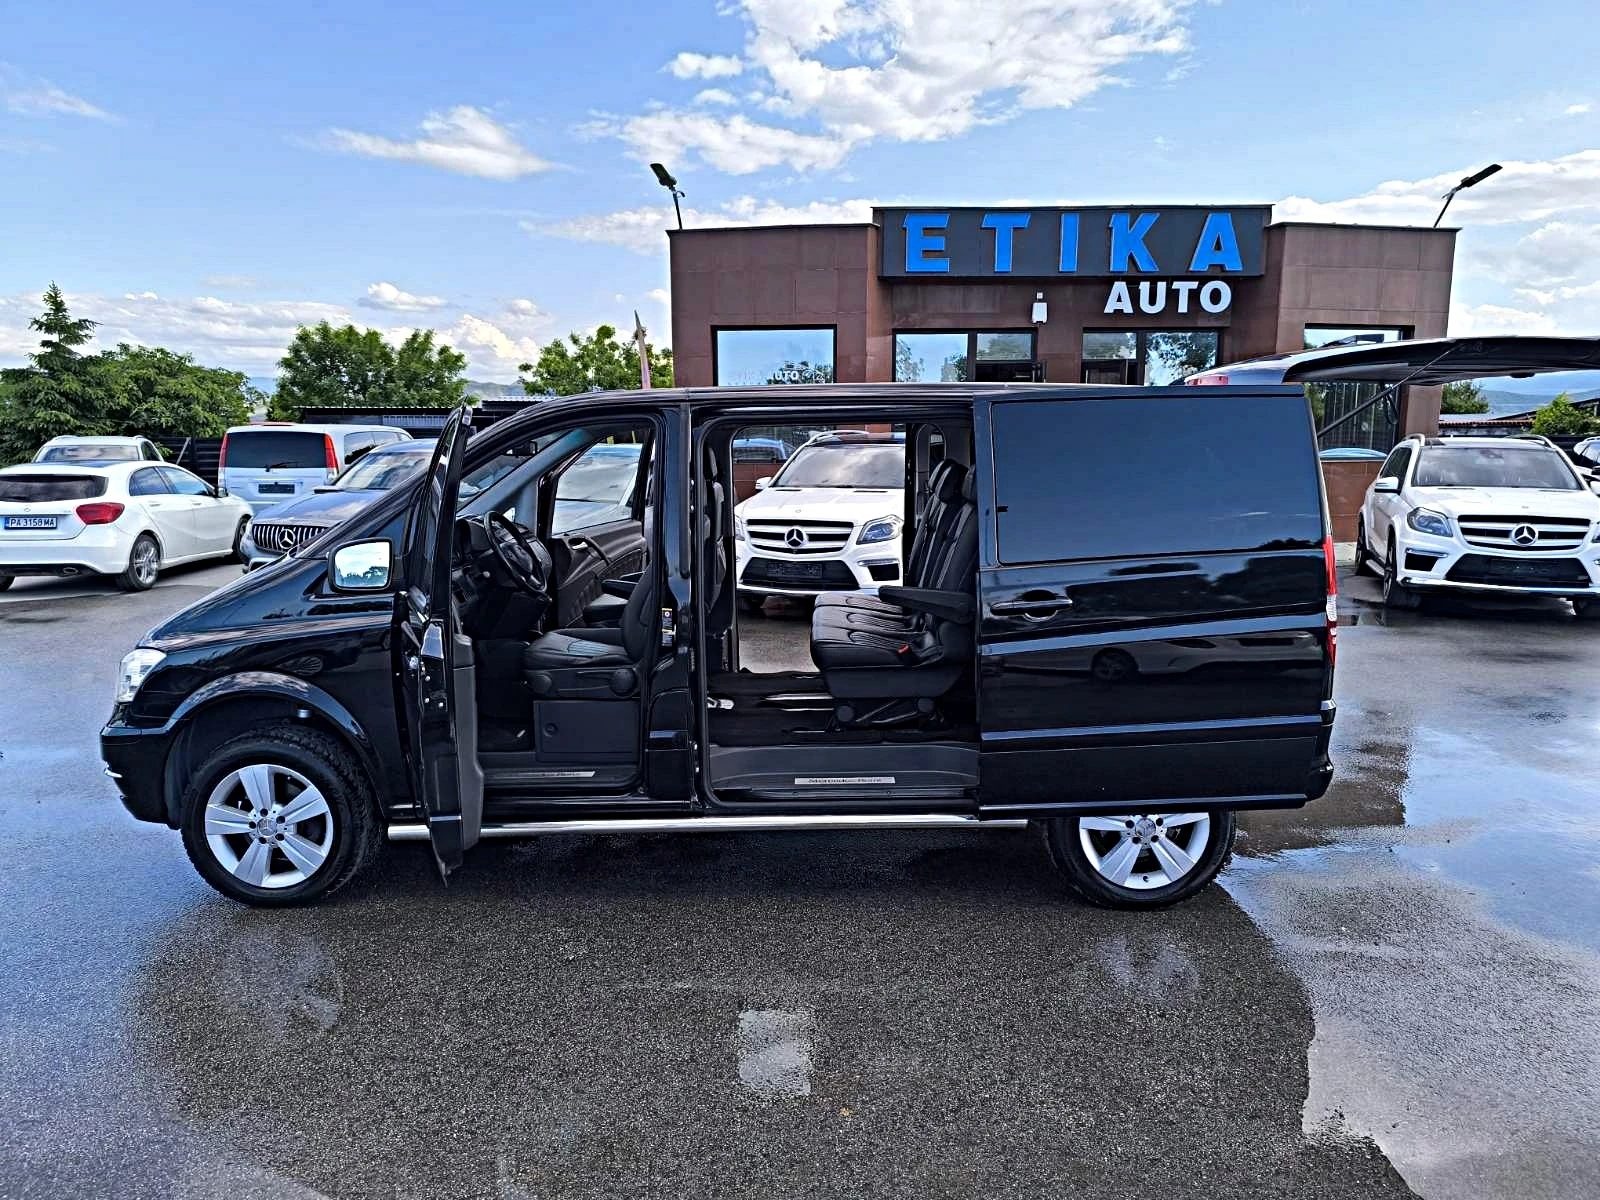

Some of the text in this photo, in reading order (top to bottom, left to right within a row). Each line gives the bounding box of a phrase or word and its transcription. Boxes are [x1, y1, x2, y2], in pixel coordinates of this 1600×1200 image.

[902, 211, 1244, 273] ETIKA
[1103, 280, 1232, 315] AUTO
[10, 518, 21, 527] PA
